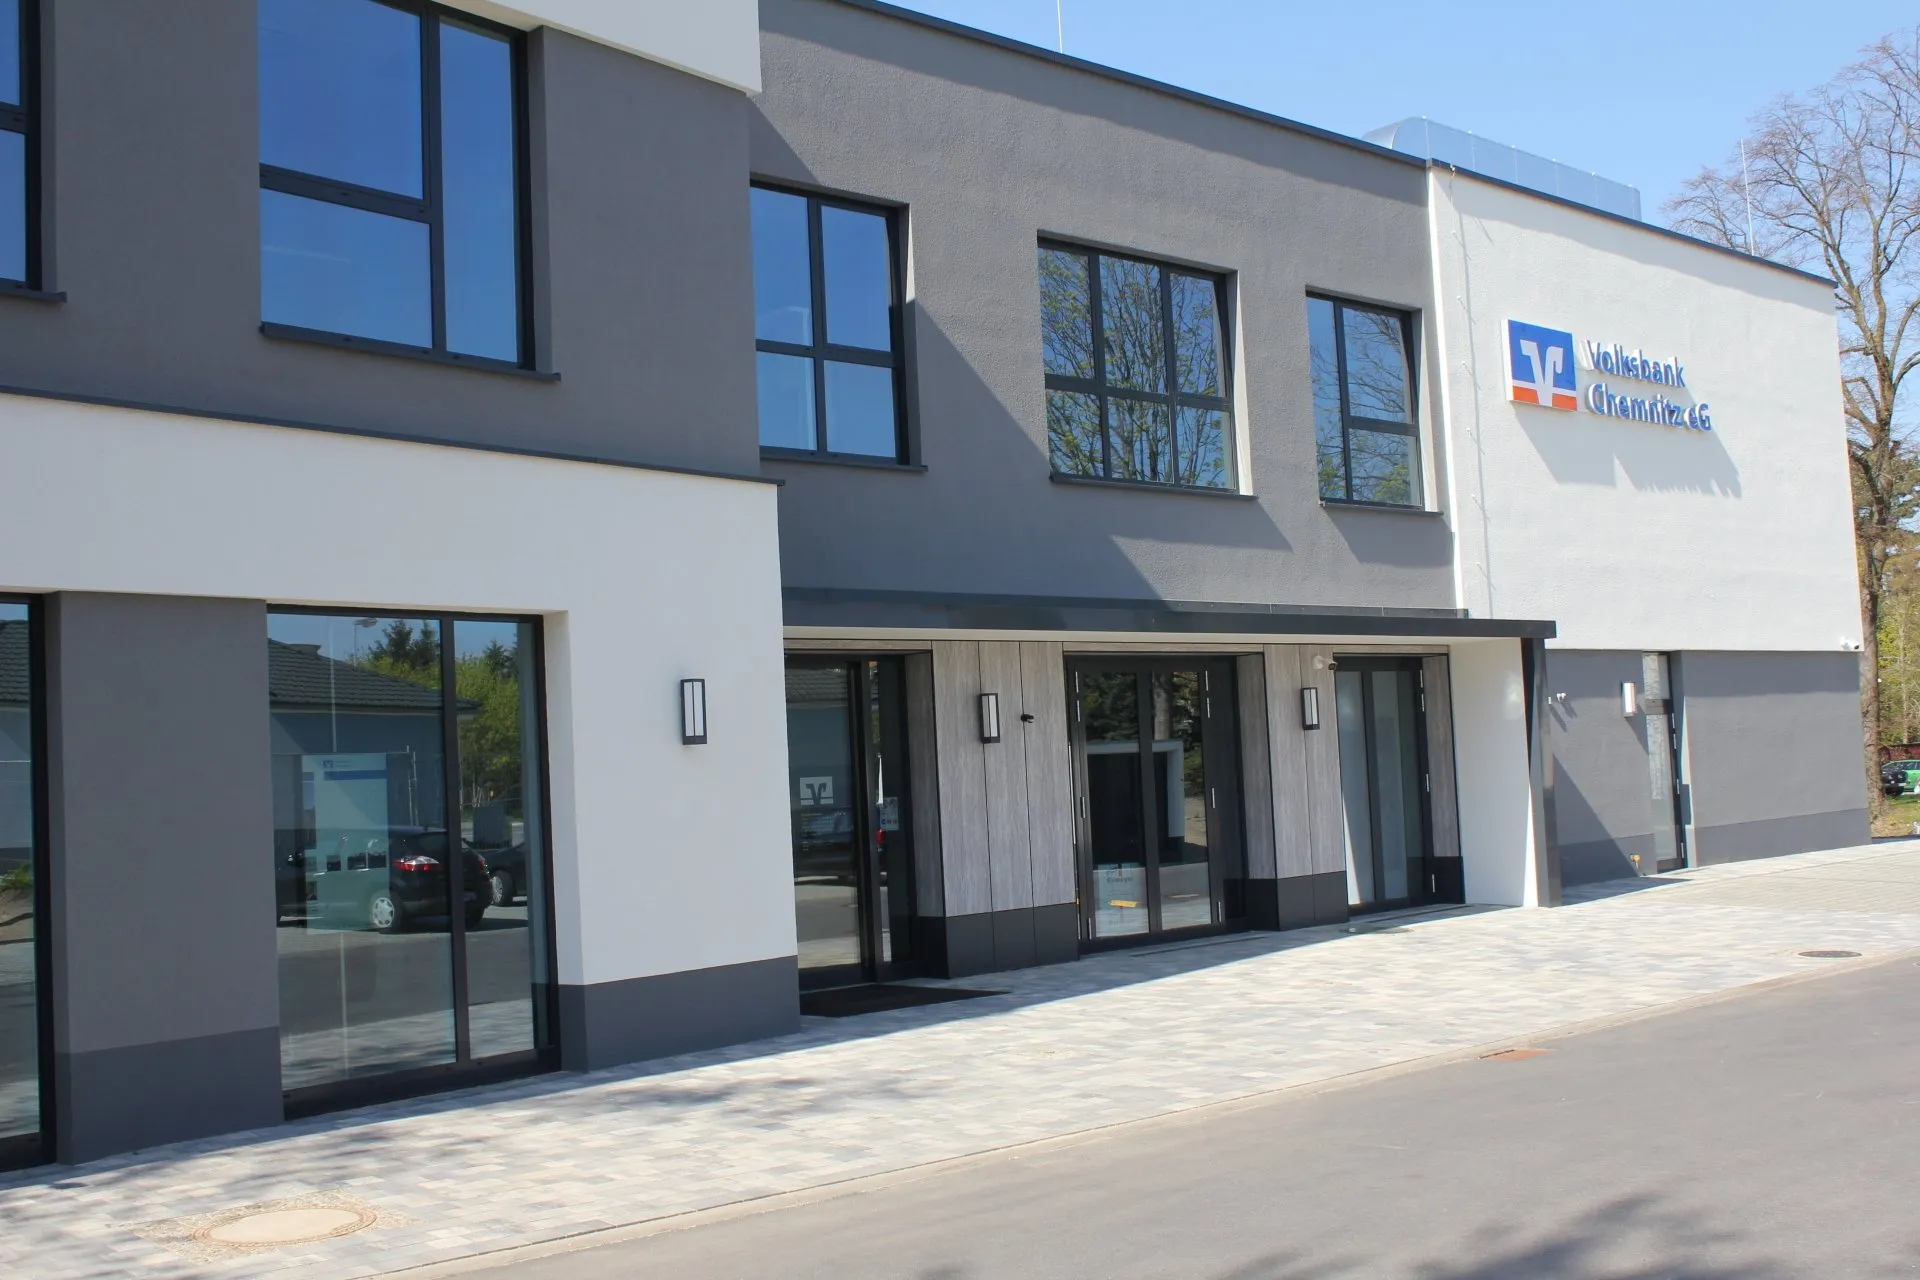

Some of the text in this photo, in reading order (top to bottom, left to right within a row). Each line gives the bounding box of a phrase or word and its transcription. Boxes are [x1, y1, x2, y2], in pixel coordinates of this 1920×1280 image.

[1584, 339, 1686, 387] Volksbank
[1589, 382, 1712, 432] Chemnitz eG
